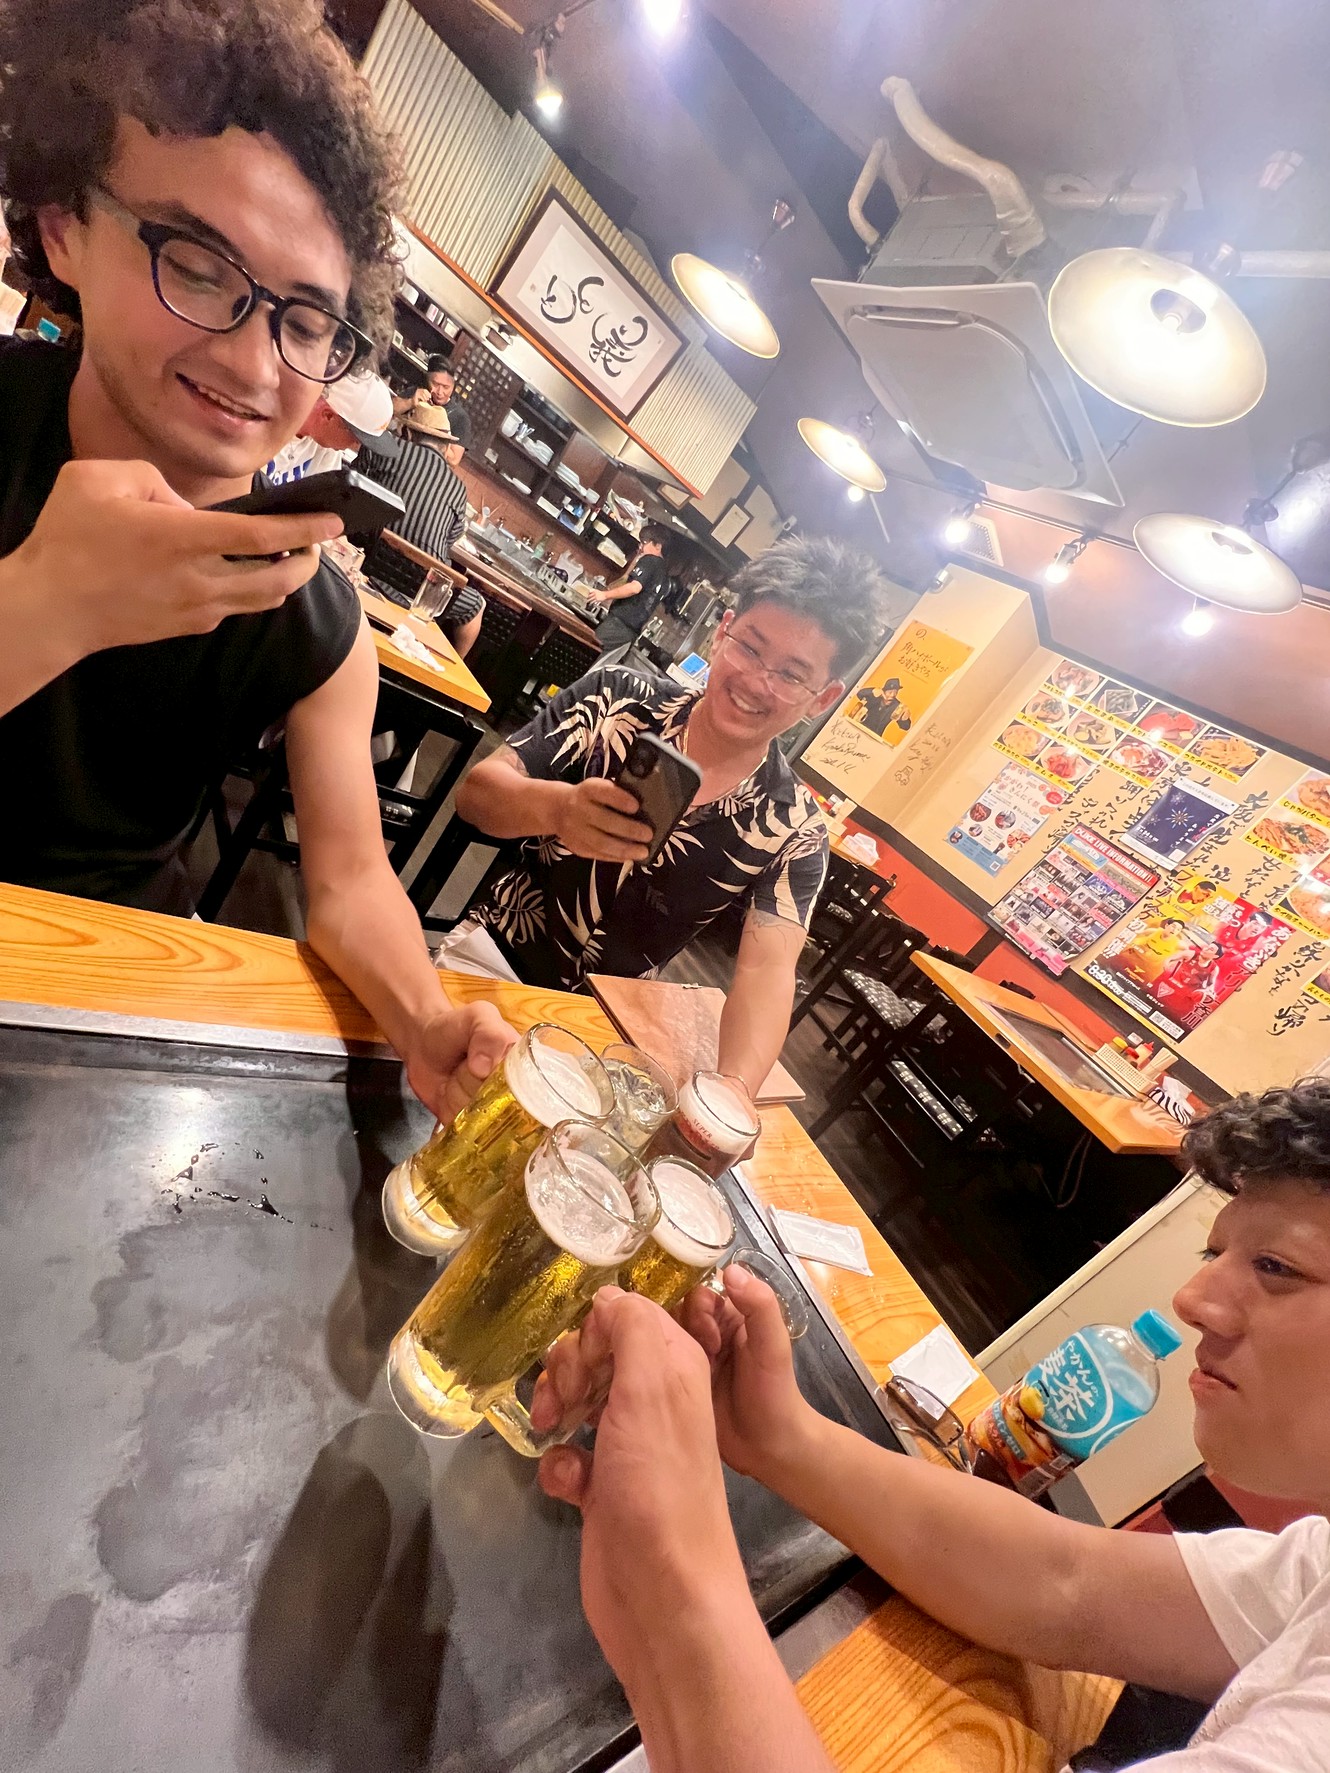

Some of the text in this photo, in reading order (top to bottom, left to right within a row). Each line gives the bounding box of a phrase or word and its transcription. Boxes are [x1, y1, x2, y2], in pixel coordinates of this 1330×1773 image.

[1283, 800, 1322, 823] じゃがバター
[1074, 828, 1096, 843] DUKE
[1094, 838, 1111, 853] LIVE
[1039, 1348, 1095, 1424] 麦茶
[1066, 1339, 1099, 1398] やかんの
